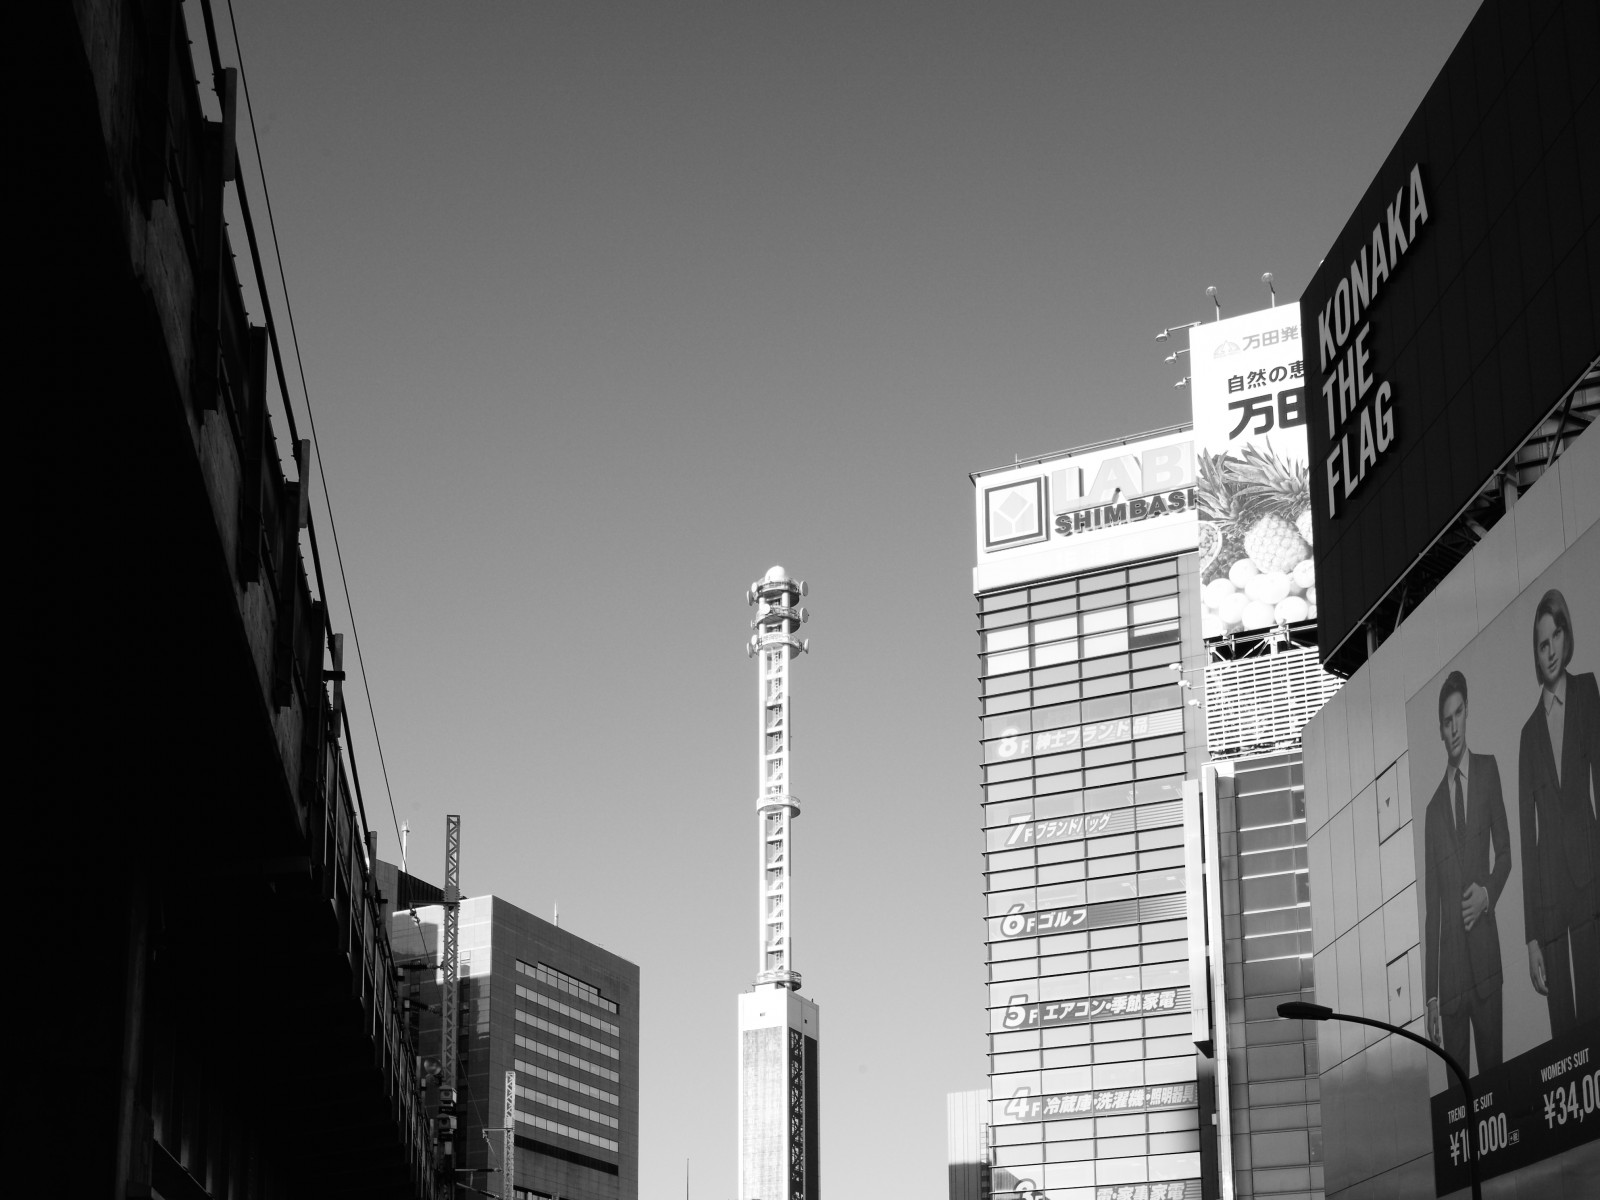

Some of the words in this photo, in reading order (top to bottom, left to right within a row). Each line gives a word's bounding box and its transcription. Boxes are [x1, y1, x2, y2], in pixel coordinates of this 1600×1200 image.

[1317, 162, 1429, 374] KONAKA
[1227, 360, 1304, 394] 自然の恵
[1322, 321, 1374, 440] THE
[1326, 380, 1395, 520] FLAG
[998, 728, 1031, 758] 8F
[1007, 814, 1033, 845] 7F
[1003, 905, 1036, 936] 6F
[1038, 908, 1087, 930] ゴルフ
[1005, 995, 1038, 1028] 5F
[1540, 1055, 1573, 1083] WOMEN'S
[1573, 1047, 1590, 1068] SUIT
[1006, 1088, 1041, 1118] 4F
[1480, 1091, 1494, 1111] SUIT
